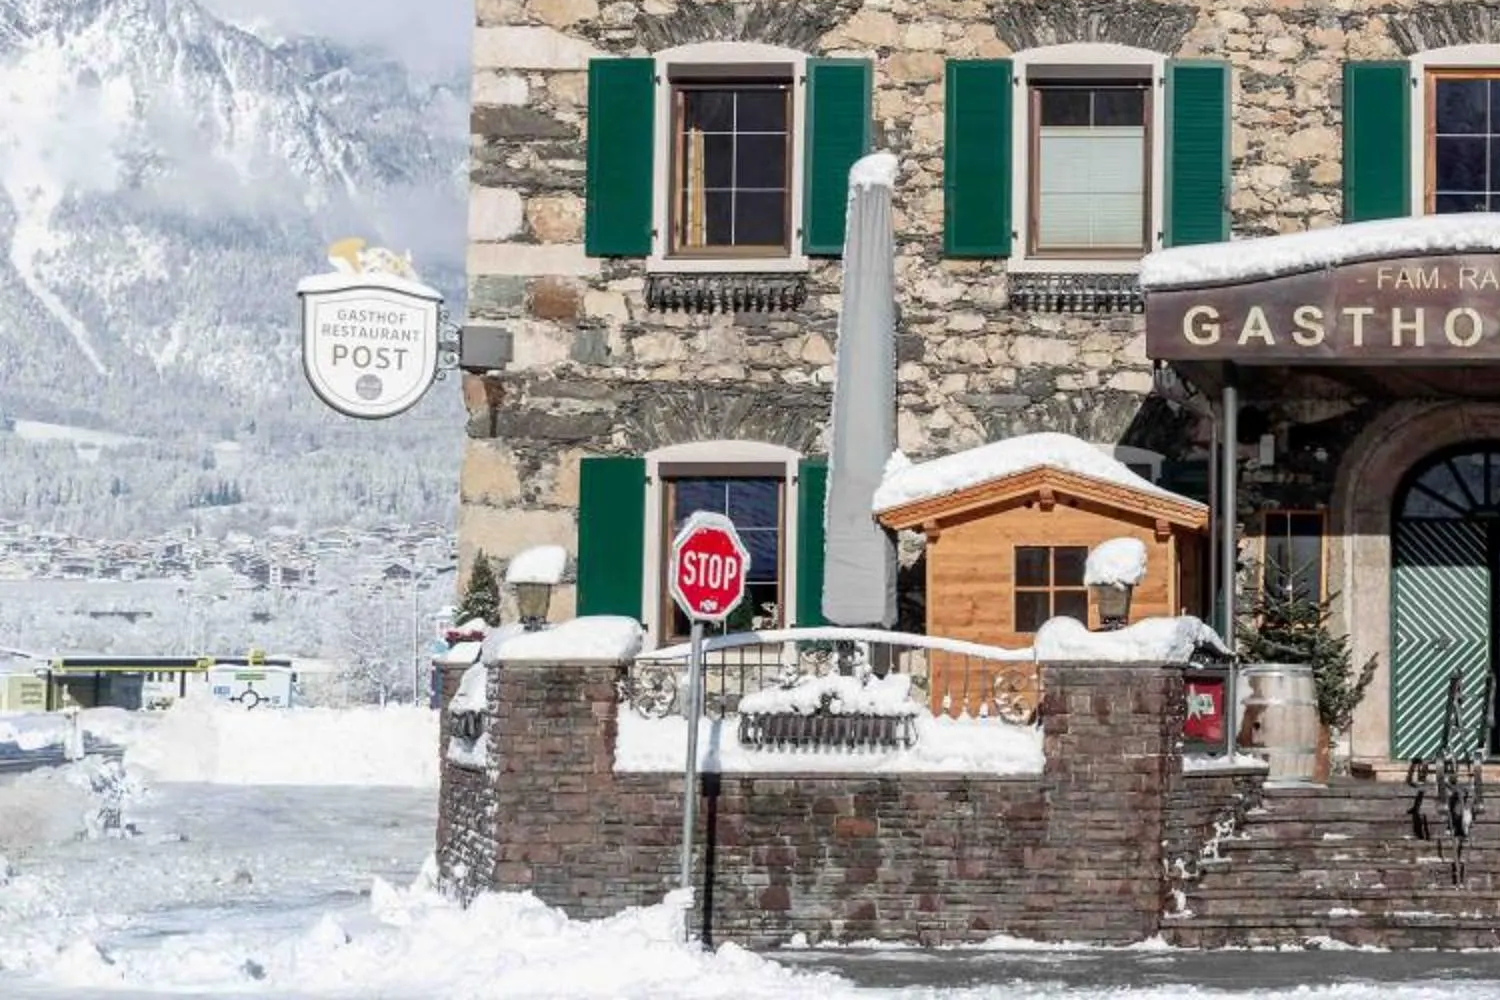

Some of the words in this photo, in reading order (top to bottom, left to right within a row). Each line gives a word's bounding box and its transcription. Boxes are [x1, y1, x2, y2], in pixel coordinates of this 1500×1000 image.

[1377, 266, 1447, 289] FAM.
[337, 309, 408, 325] GASTHOF
[321, 323, 419, 342] RESTAURANT
[332, 344, 409, 371] POST
[683, 550, 737, 590] STOP
